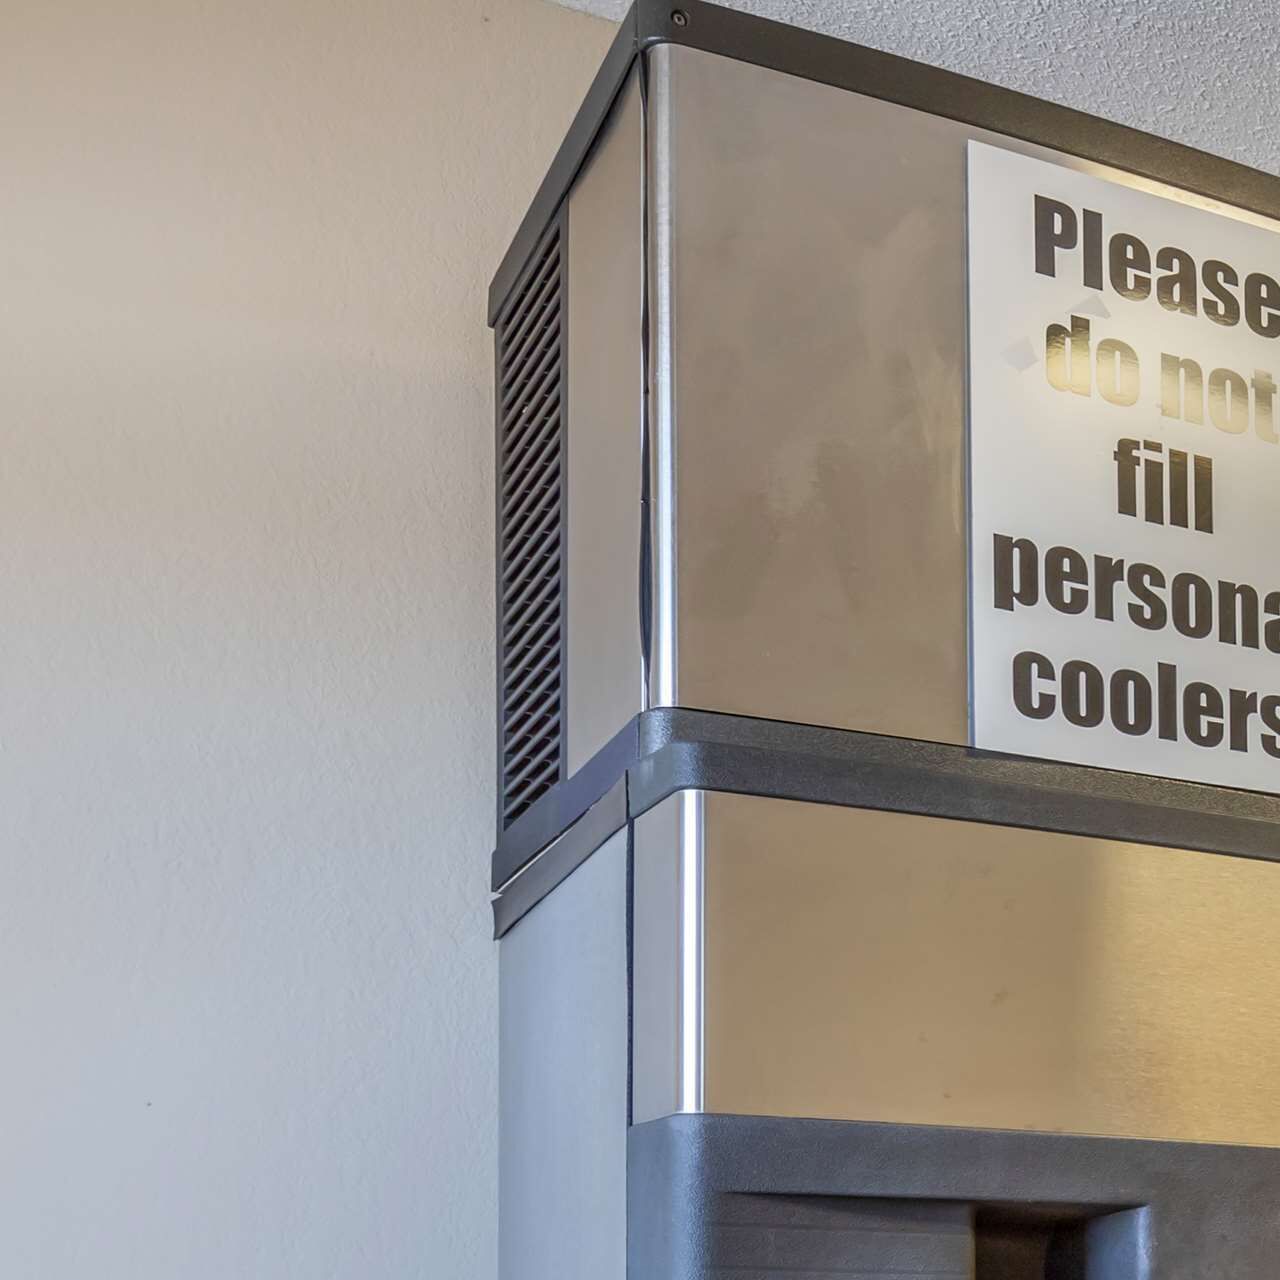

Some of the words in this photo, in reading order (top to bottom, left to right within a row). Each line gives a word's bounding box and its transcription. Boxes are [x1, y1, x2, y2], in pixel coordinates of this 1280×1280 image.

[1044, 314, 1140, 408] do
[1159, 351, 1279, 444] not
[1112, 438, 1214, 534] fill
